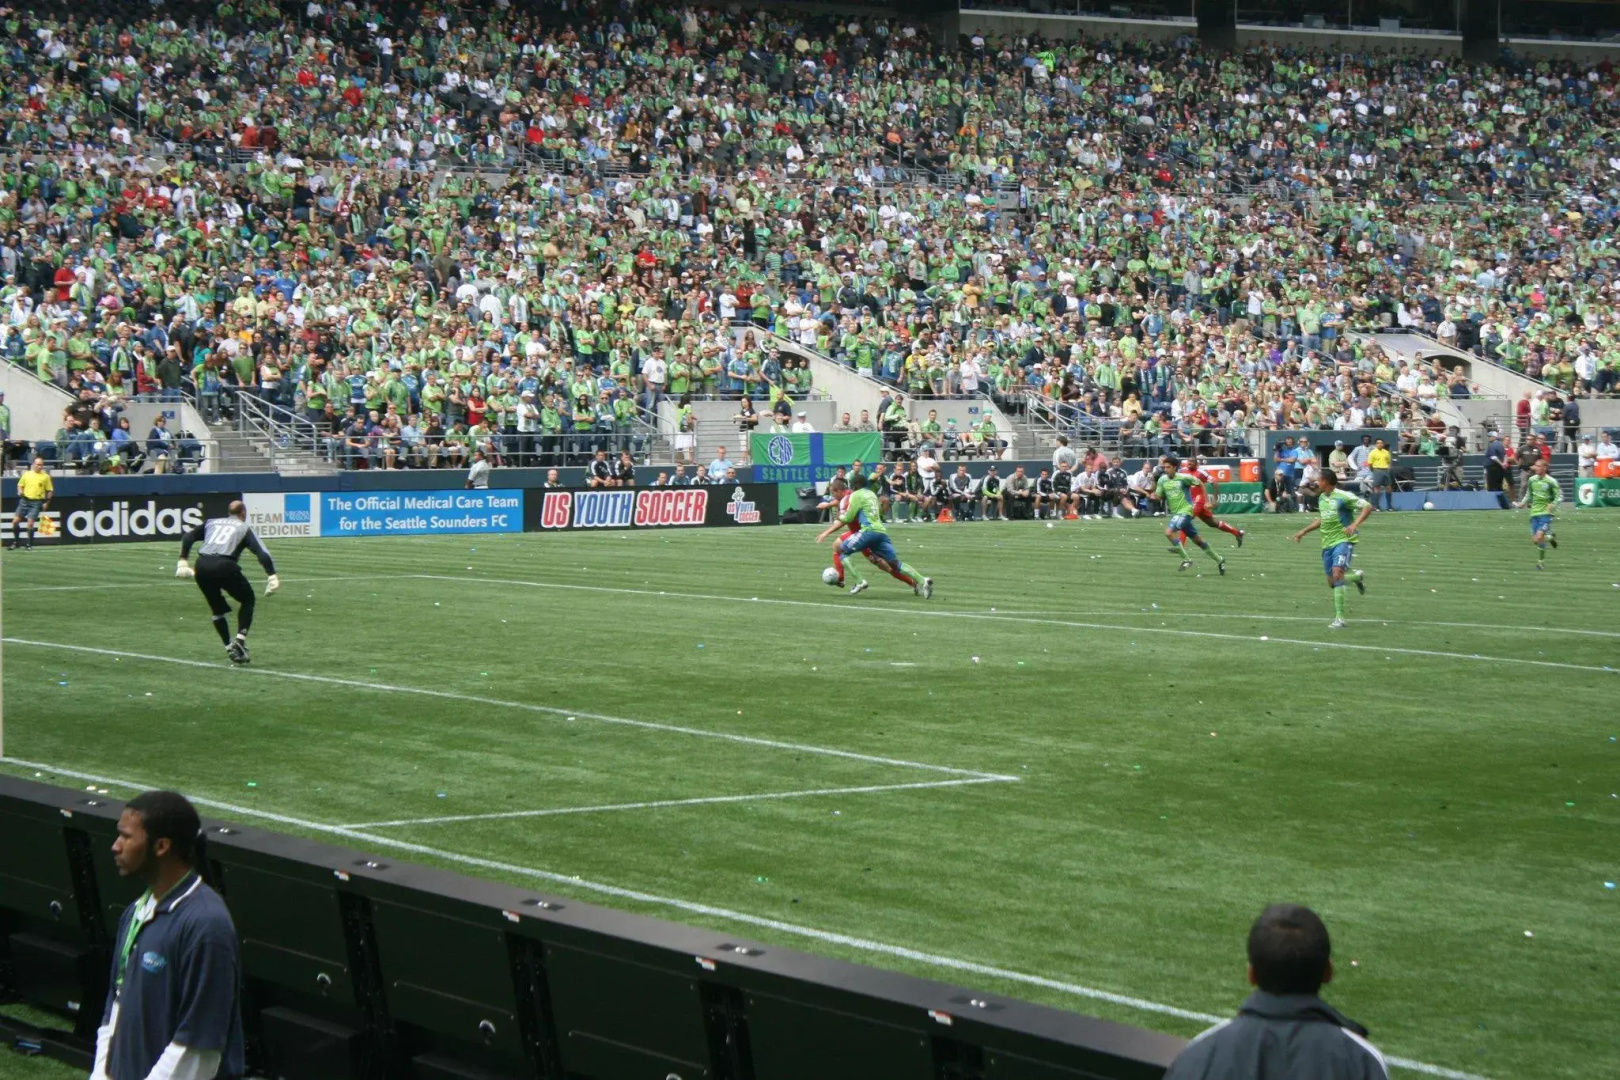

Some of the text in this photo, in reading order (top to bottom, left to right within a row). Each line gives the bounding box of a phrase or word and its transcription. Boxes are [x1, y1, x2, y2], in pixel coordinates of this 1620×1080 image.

[762, 465, 872, 480] SEATTLE SOURS
[1251, 492, 1261, 504] G
[1579, 483, 1595, 505] G
[328, 495, 519, 511] The Official Medical Care Team
[543, 490, 708, 527] US YOUTH SOCCER
[727, 502, 736, 513] US
[67, 500, 203, 537] adidas
[250, 513, 282, 524] TEAM
[339, 514, 508, 530] for the Seattle Sounders FC
[739, 511, 760, 522] SOCCER
[208, 525, 236, 544] 18
[250, 525, 311, 536] MEDICINE
